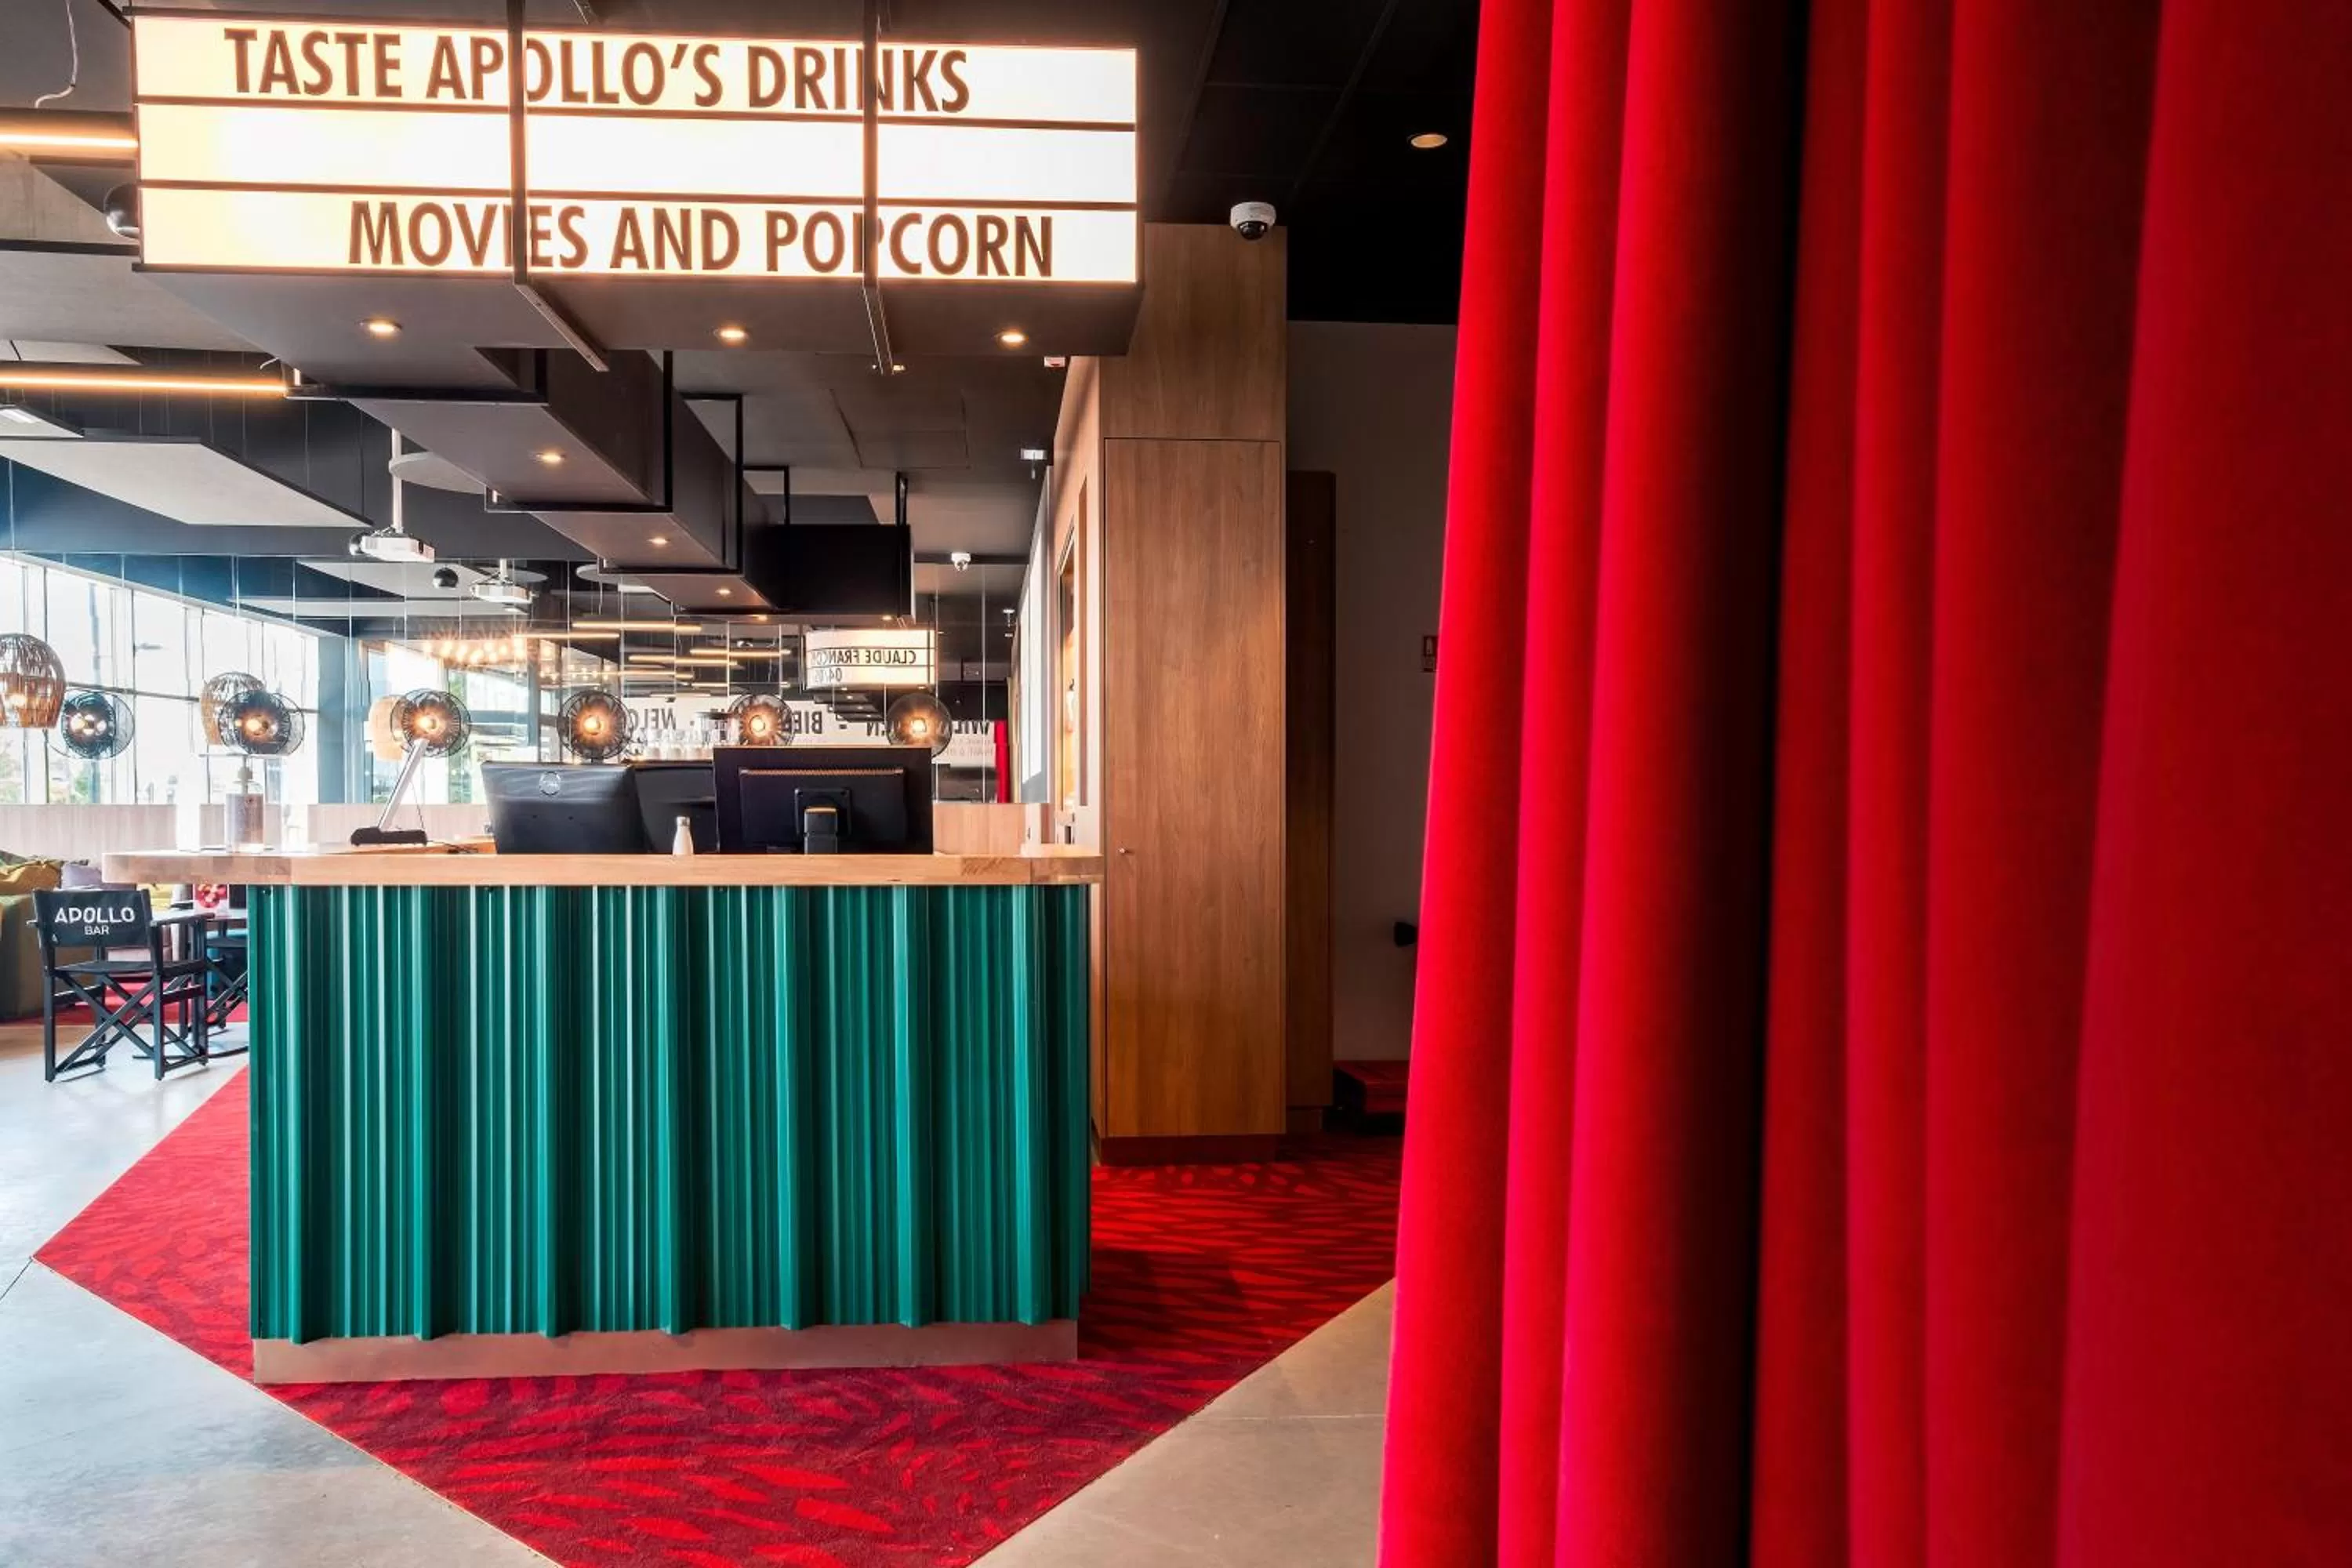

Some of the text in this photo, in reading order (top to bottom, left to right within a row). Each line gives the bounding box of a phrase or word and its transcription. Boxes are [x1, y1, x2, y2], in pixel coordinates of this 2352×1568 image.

[223, 27, 403, 98] TASTE
[747, 45, 970, 114] DRINKS
[348, 200, 1053, 278] MOVIES AND POPCORN
[54, 907, 135, 924] APOLLO
[84, 925, 110, 935] BAR
